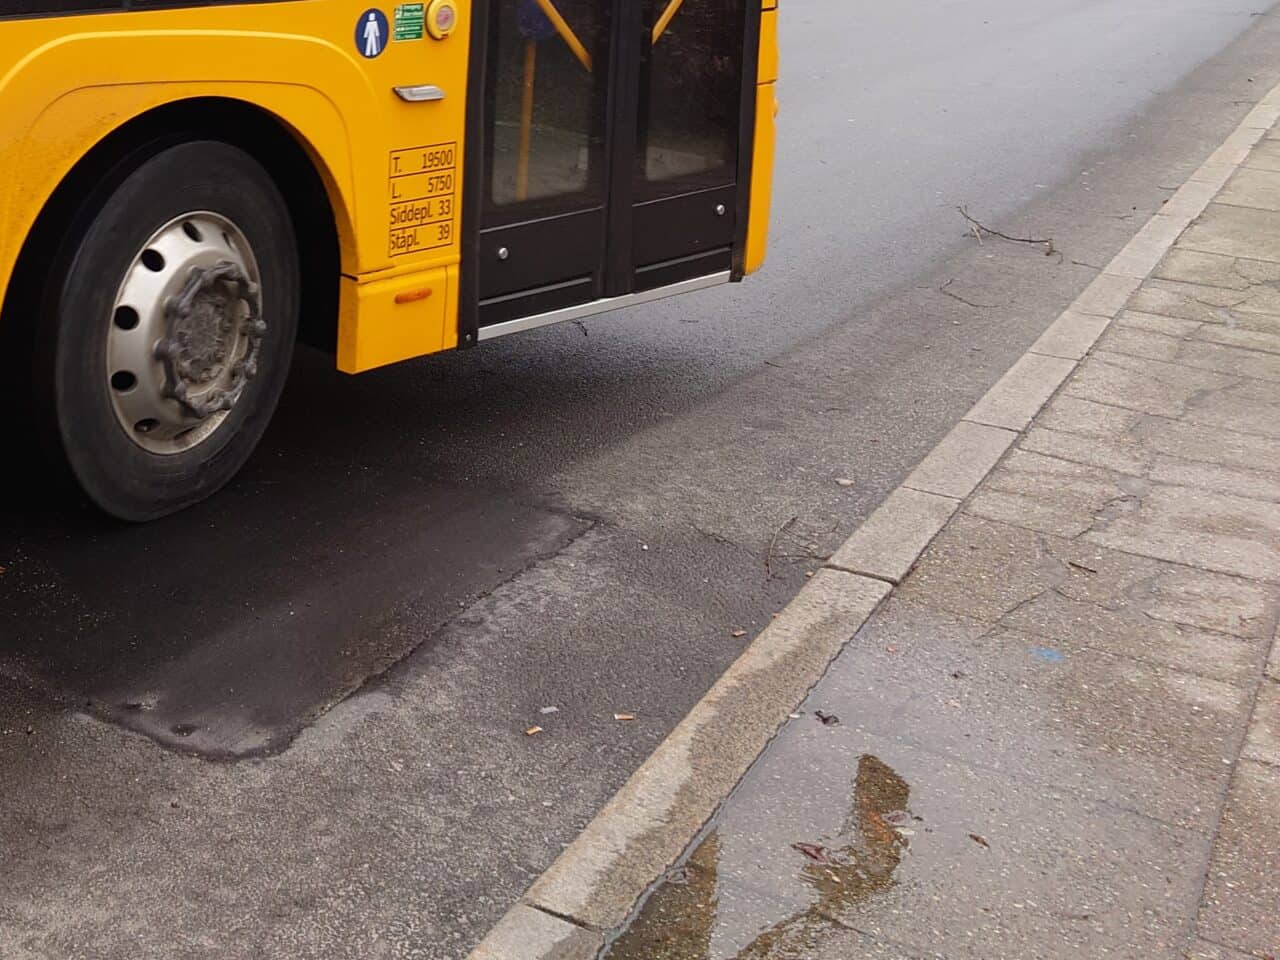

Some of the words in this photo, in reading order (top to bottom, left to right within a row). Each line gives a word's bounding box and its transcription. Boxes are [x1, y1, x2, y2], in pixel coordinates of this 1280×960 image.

[422, 149, 453, 169] 19500
[427, 174, 452, 193] 5750
[438, 199, 451, 217] 33
[438, 224, 450, 241] 39
